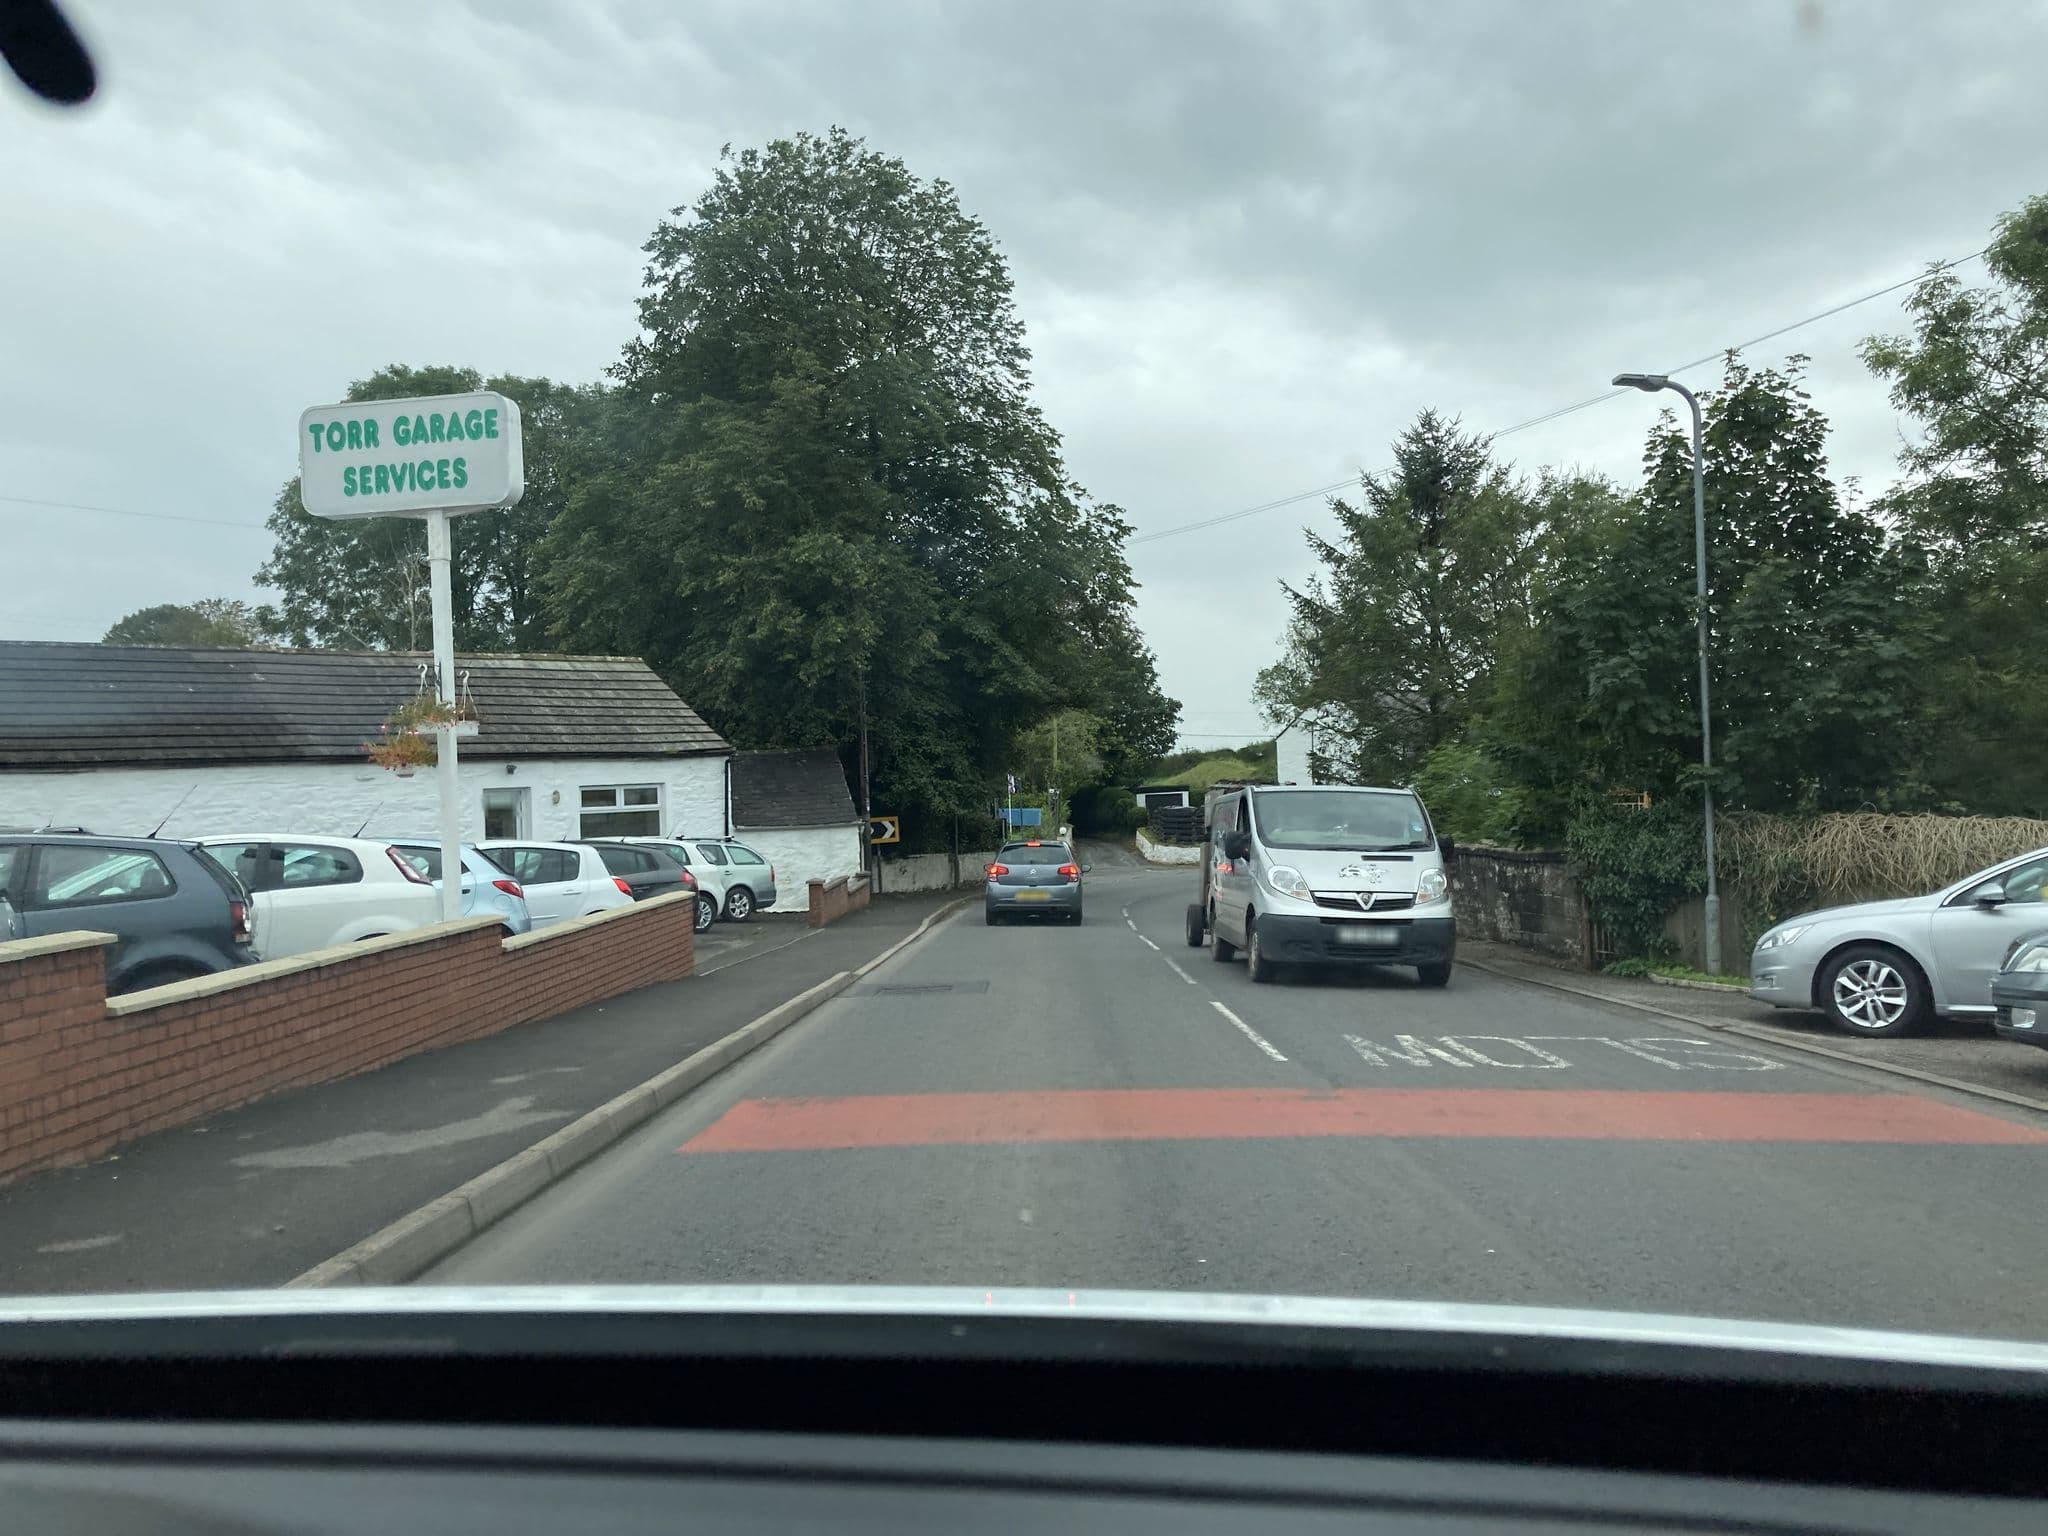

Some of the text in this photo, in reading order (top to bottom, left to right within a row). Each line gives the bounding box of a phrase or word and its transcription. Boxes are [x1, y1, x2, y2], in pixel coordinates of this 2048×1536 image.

[309, 408, 499, 453] TORR GARAGE
[343, 457, 468, 497] SERVICES
[1343, 1033, 1786, 1071] SLOW
